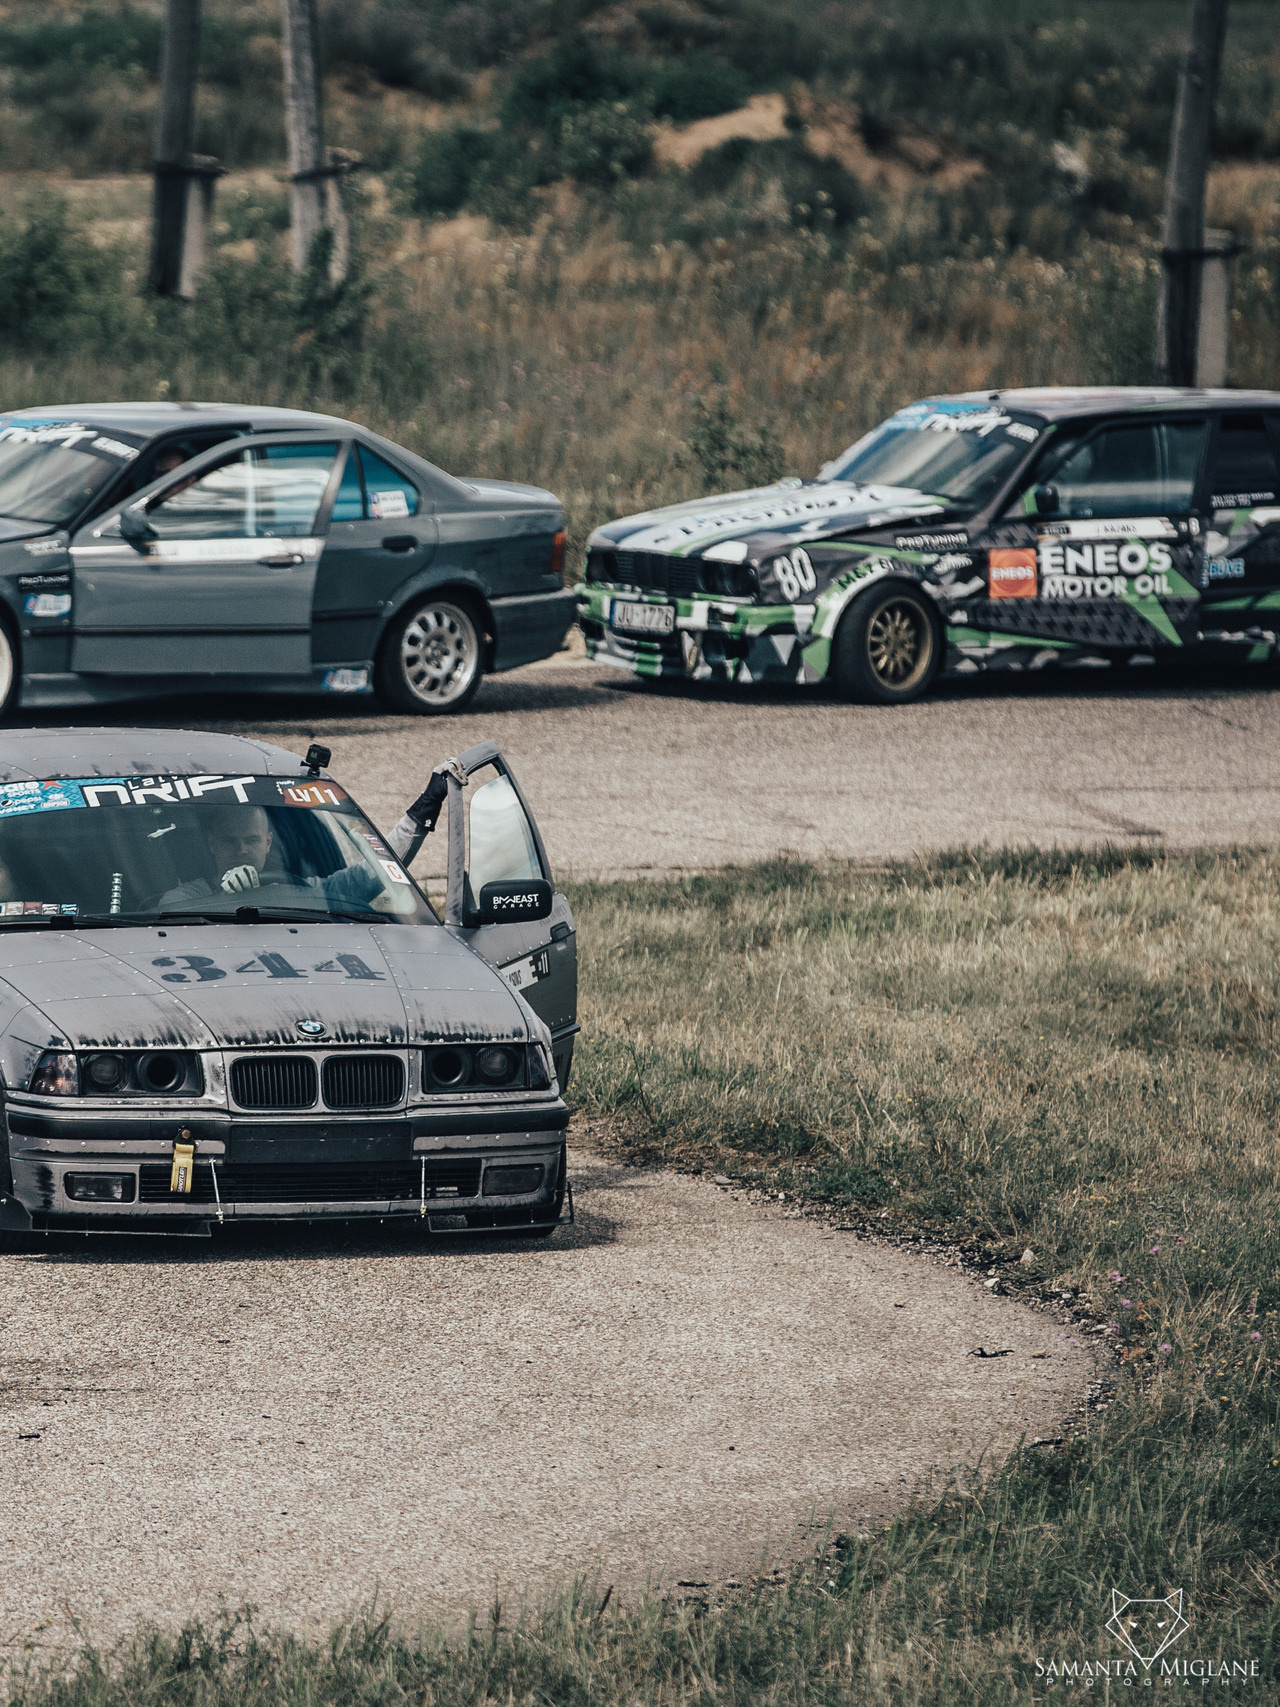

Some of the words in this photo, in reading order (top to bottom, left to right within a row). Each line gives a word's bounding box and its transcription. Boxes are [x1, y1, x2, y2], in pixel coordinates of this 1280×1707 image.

[773, 547, 817, 601] 80
[990, 565, 1035, 581] ENEOS
[1042, 543, 1172, 575] ENEOS
[1041, 575, 1128, 599] MOTOR
[1134, 574, 1173, 597] OIL
[82, 775, 255, 808] DRIFT
[493, 902, 540, 910] GARAGE
[151, 952, 387, 983] 344
